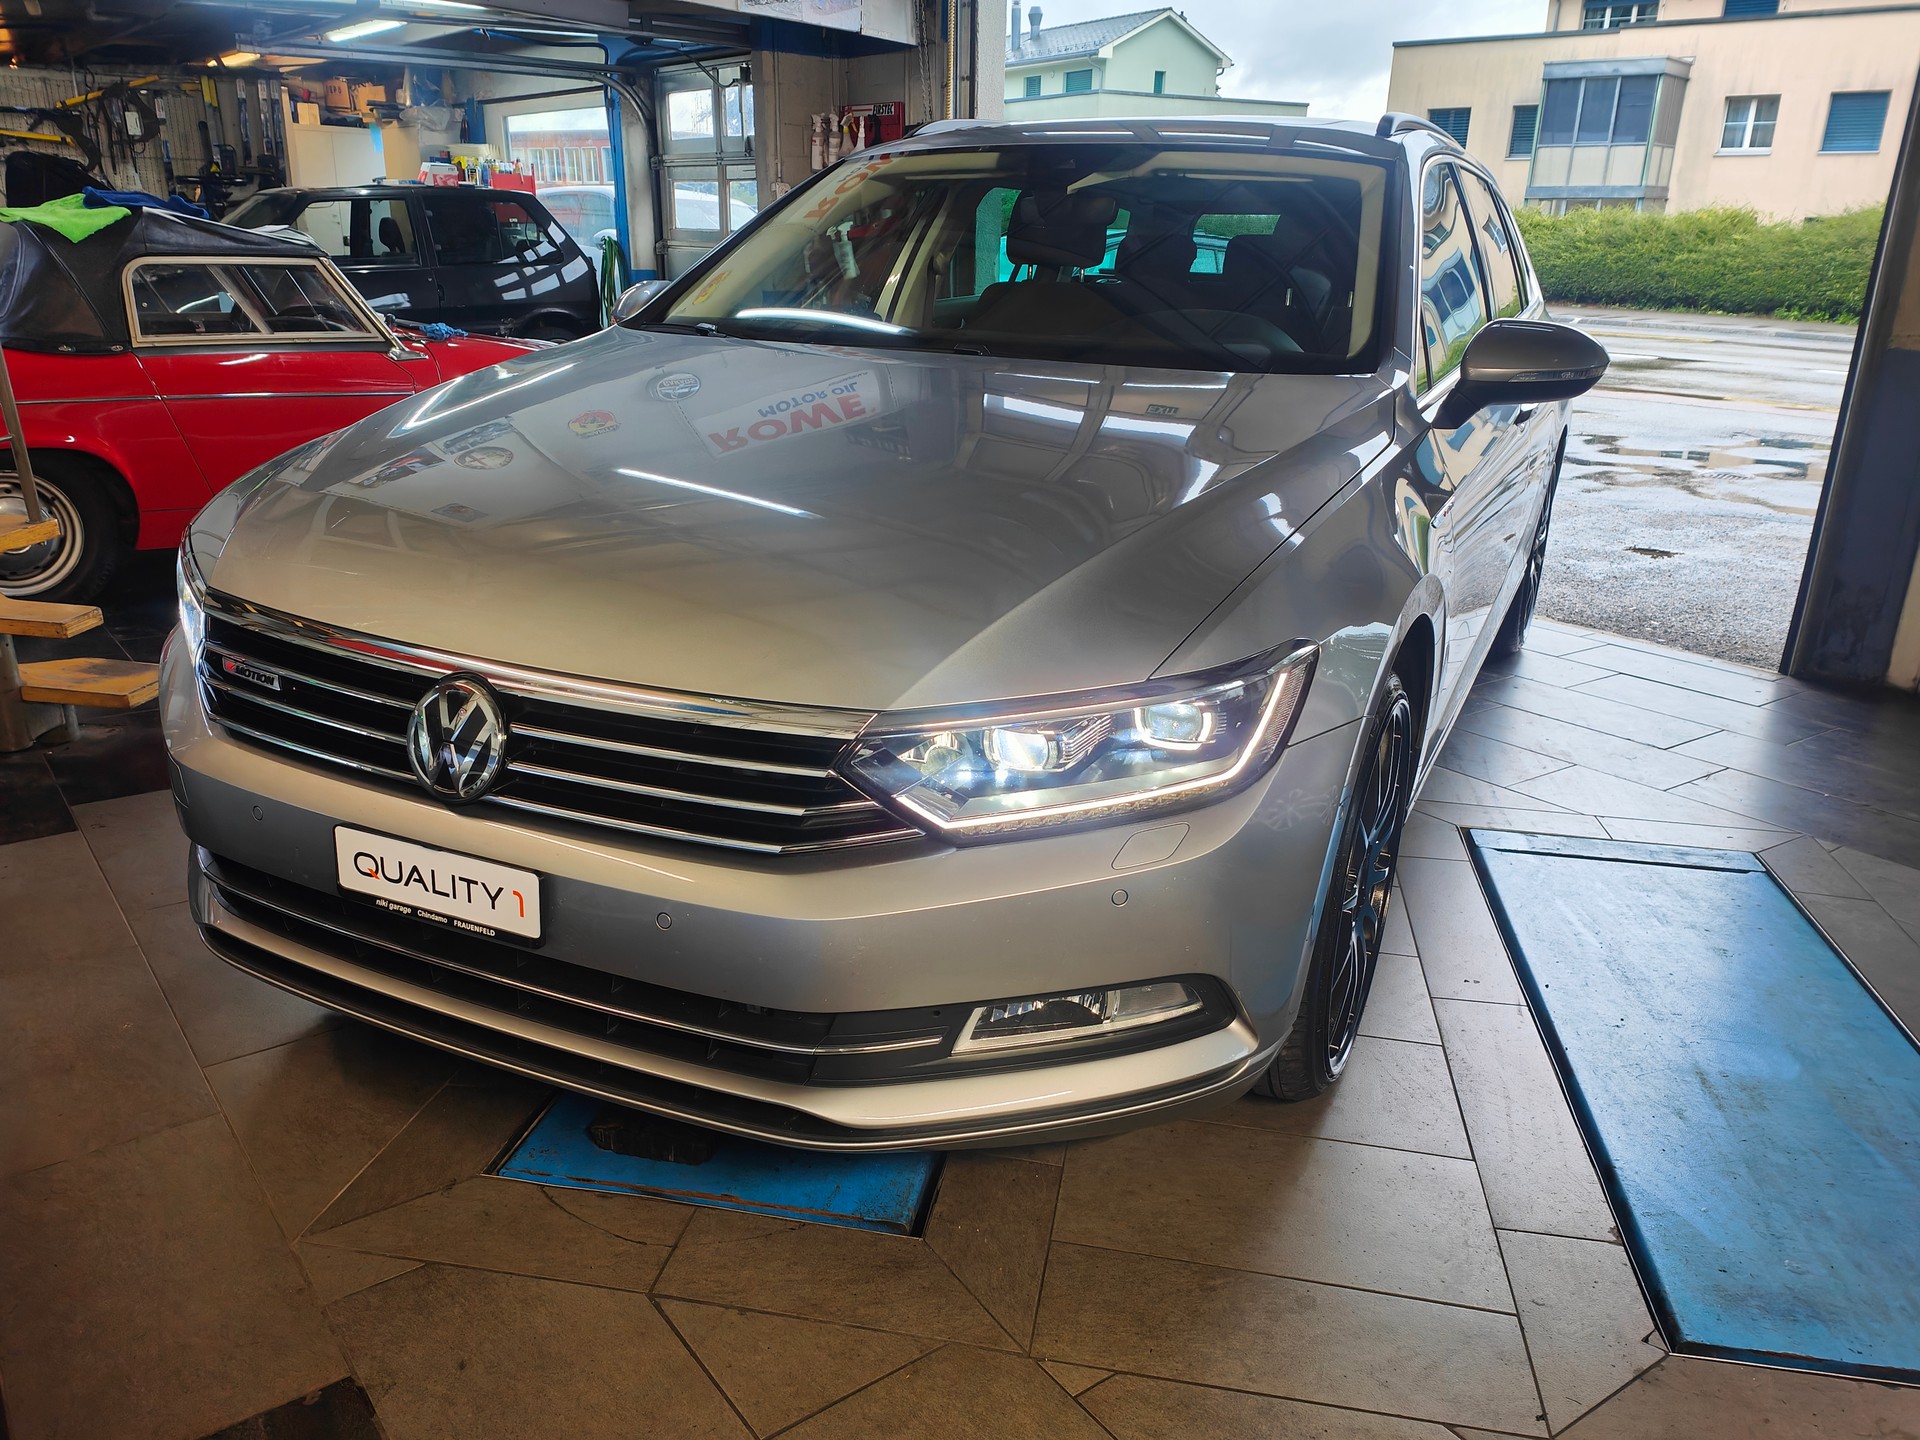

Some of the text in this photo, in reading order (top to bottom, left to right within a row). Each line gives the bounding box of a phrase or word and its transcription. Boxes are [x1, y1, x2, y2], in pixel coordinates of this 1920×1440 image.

[353, 851, 525, 918] QUALITY 1
[375, 898, 496, 936] niki garage Chindamo FRAUENFELD
